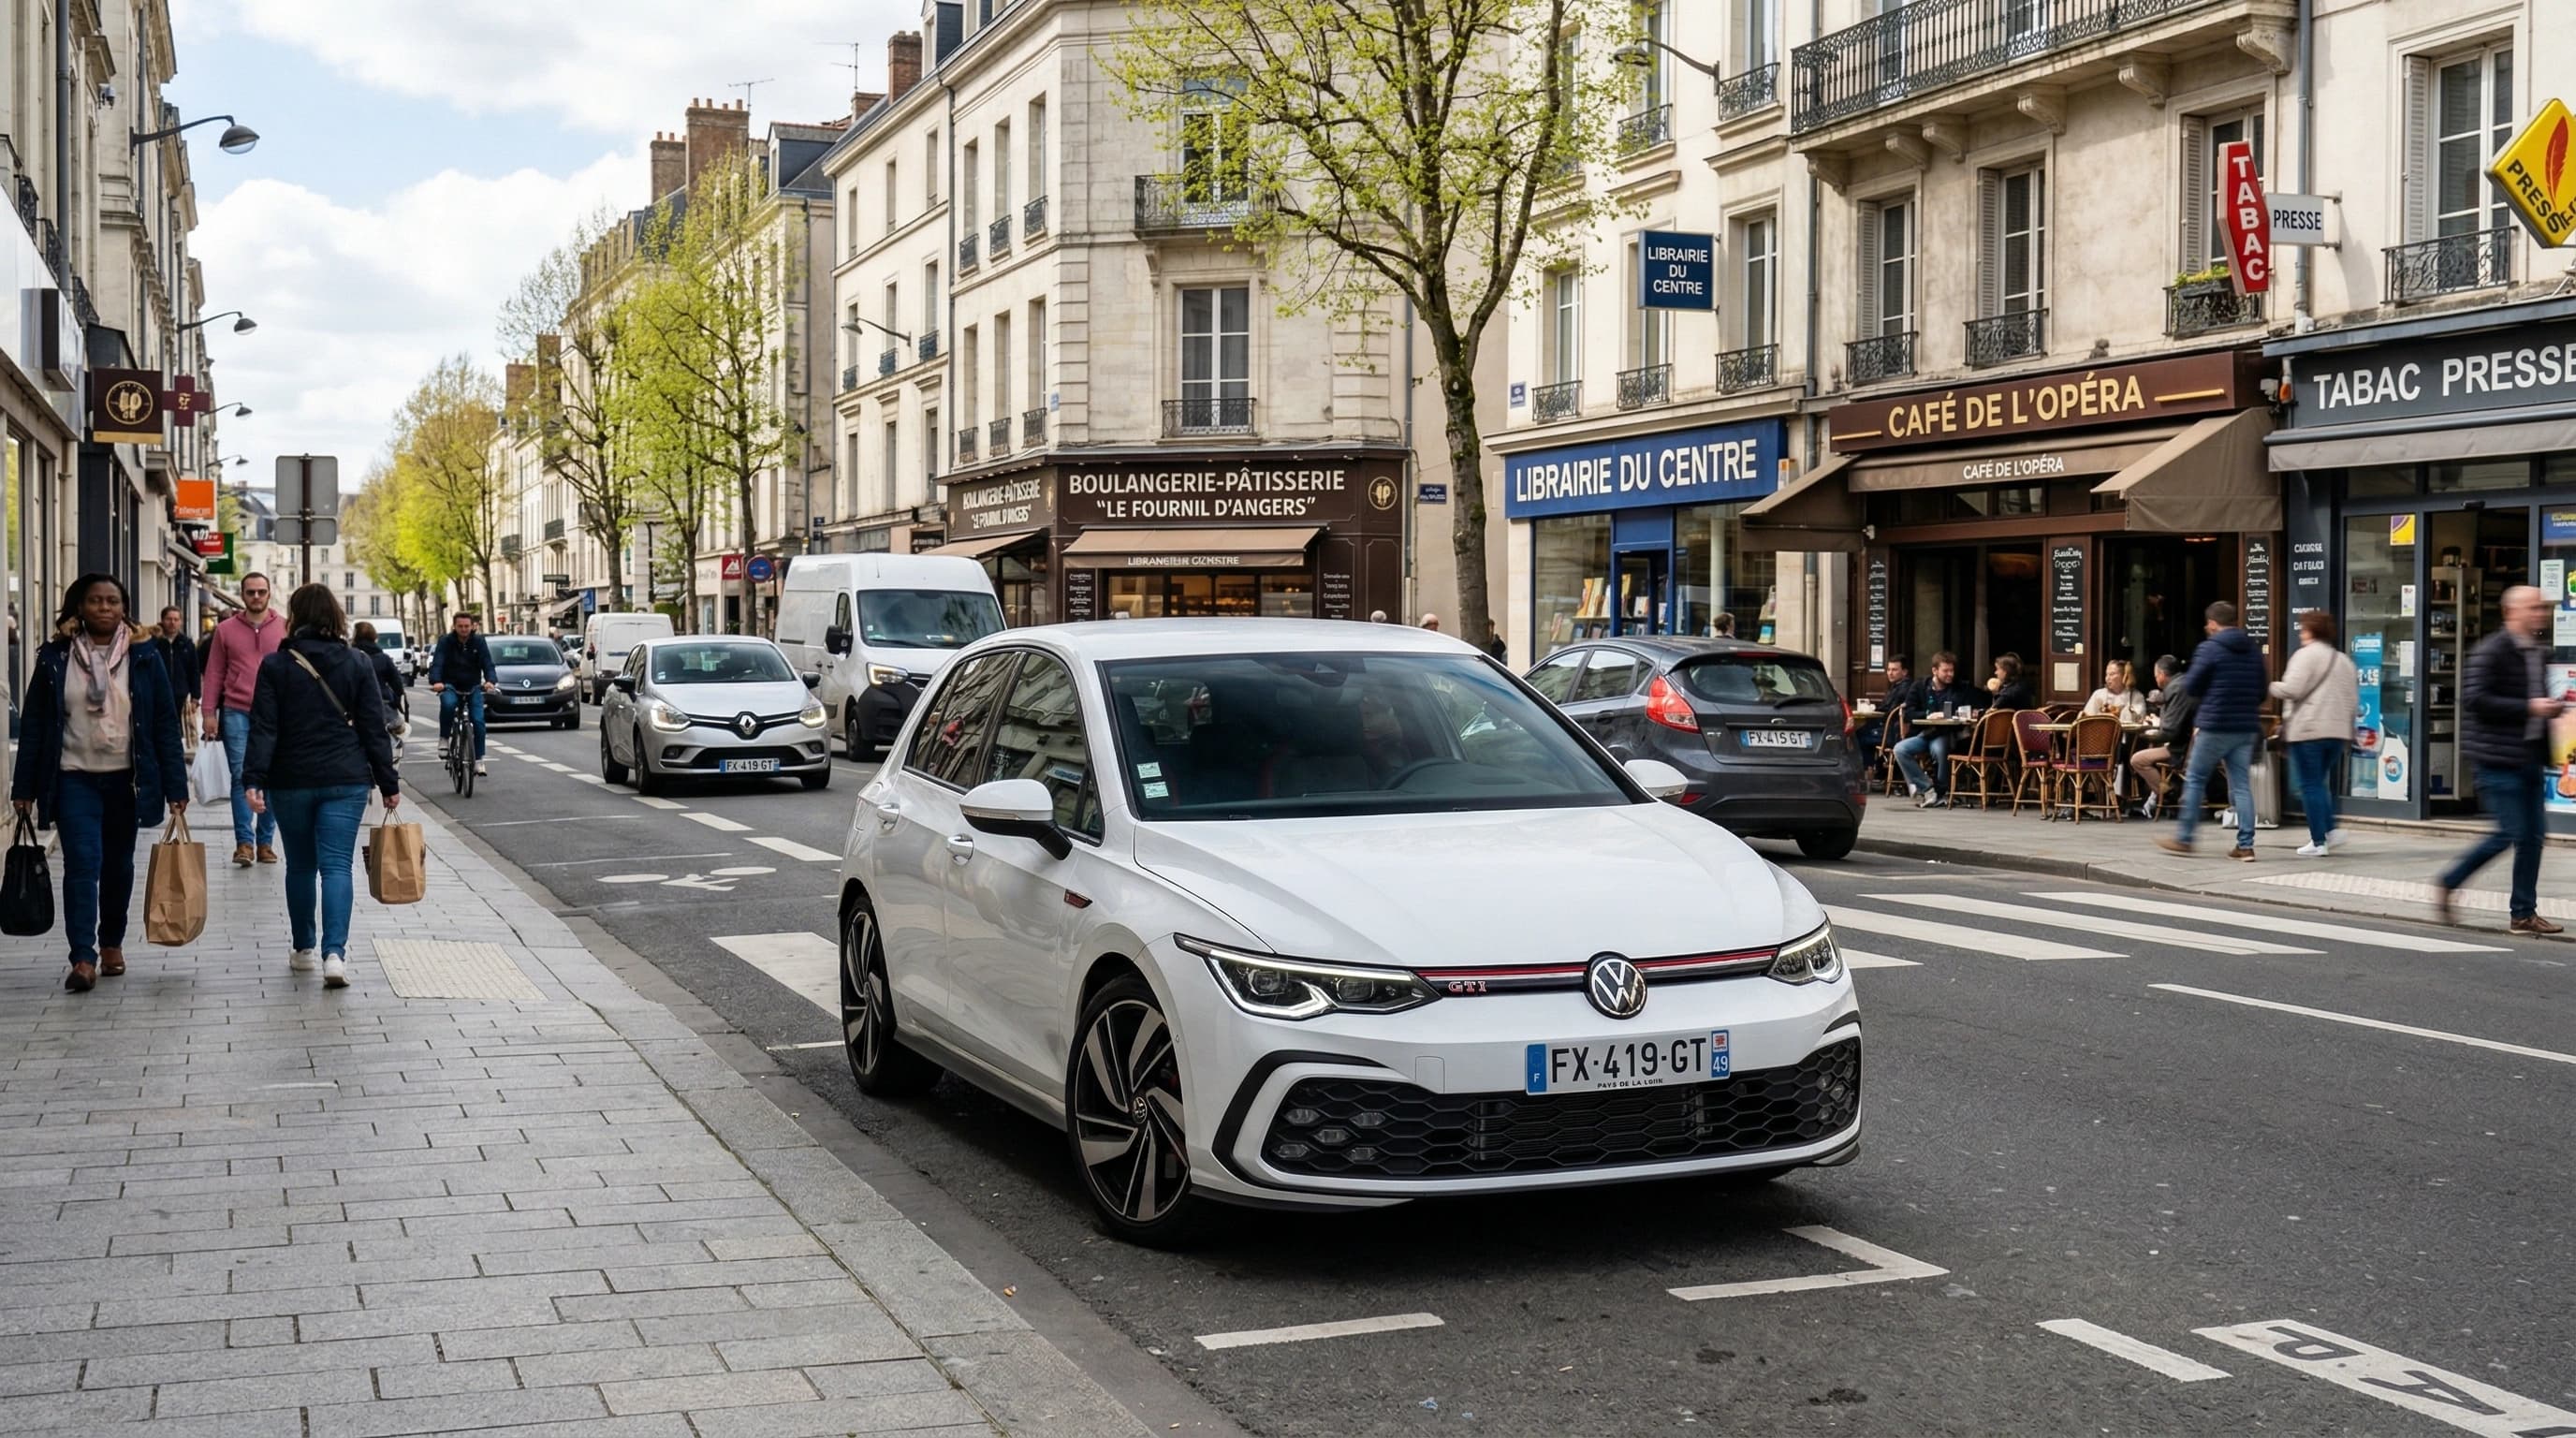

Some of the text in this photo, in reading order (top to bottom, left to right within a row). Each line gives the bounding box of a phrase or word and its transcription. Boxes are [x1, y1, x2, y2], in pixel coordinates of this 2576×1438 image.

[2232, 155, 2266, 281] TABAC
[2273, 209, 2322, 230] PRESSE
[1647, 246, 1708, 263] LIBRAIRIE
[1669, 264, 1687, 278] DU
[1653, 279, 1704, 296] CENTRE
[2313, 362, 2422, 410] TABAC
[1888, 371, 2145, 438] CAFÉ DE L'OPÉRA
[1515, 438, 1757, 503] LIBRAIRIE DU CENTRE
[1963, 453, 2065, 479] CAFÉ DE L'OPÉRA
[1069, 466, 1345, 494] BOULANGERIE-PÂTISSERIE
[1132, 500, 1209, 517] FOURNIL
[760, 759, 773, 770] GT
[1448, 980, 1486, 993] GTI
[1712, 1055, 1729, 1073] 49
[1533, 1073, 1541, 1083] F
